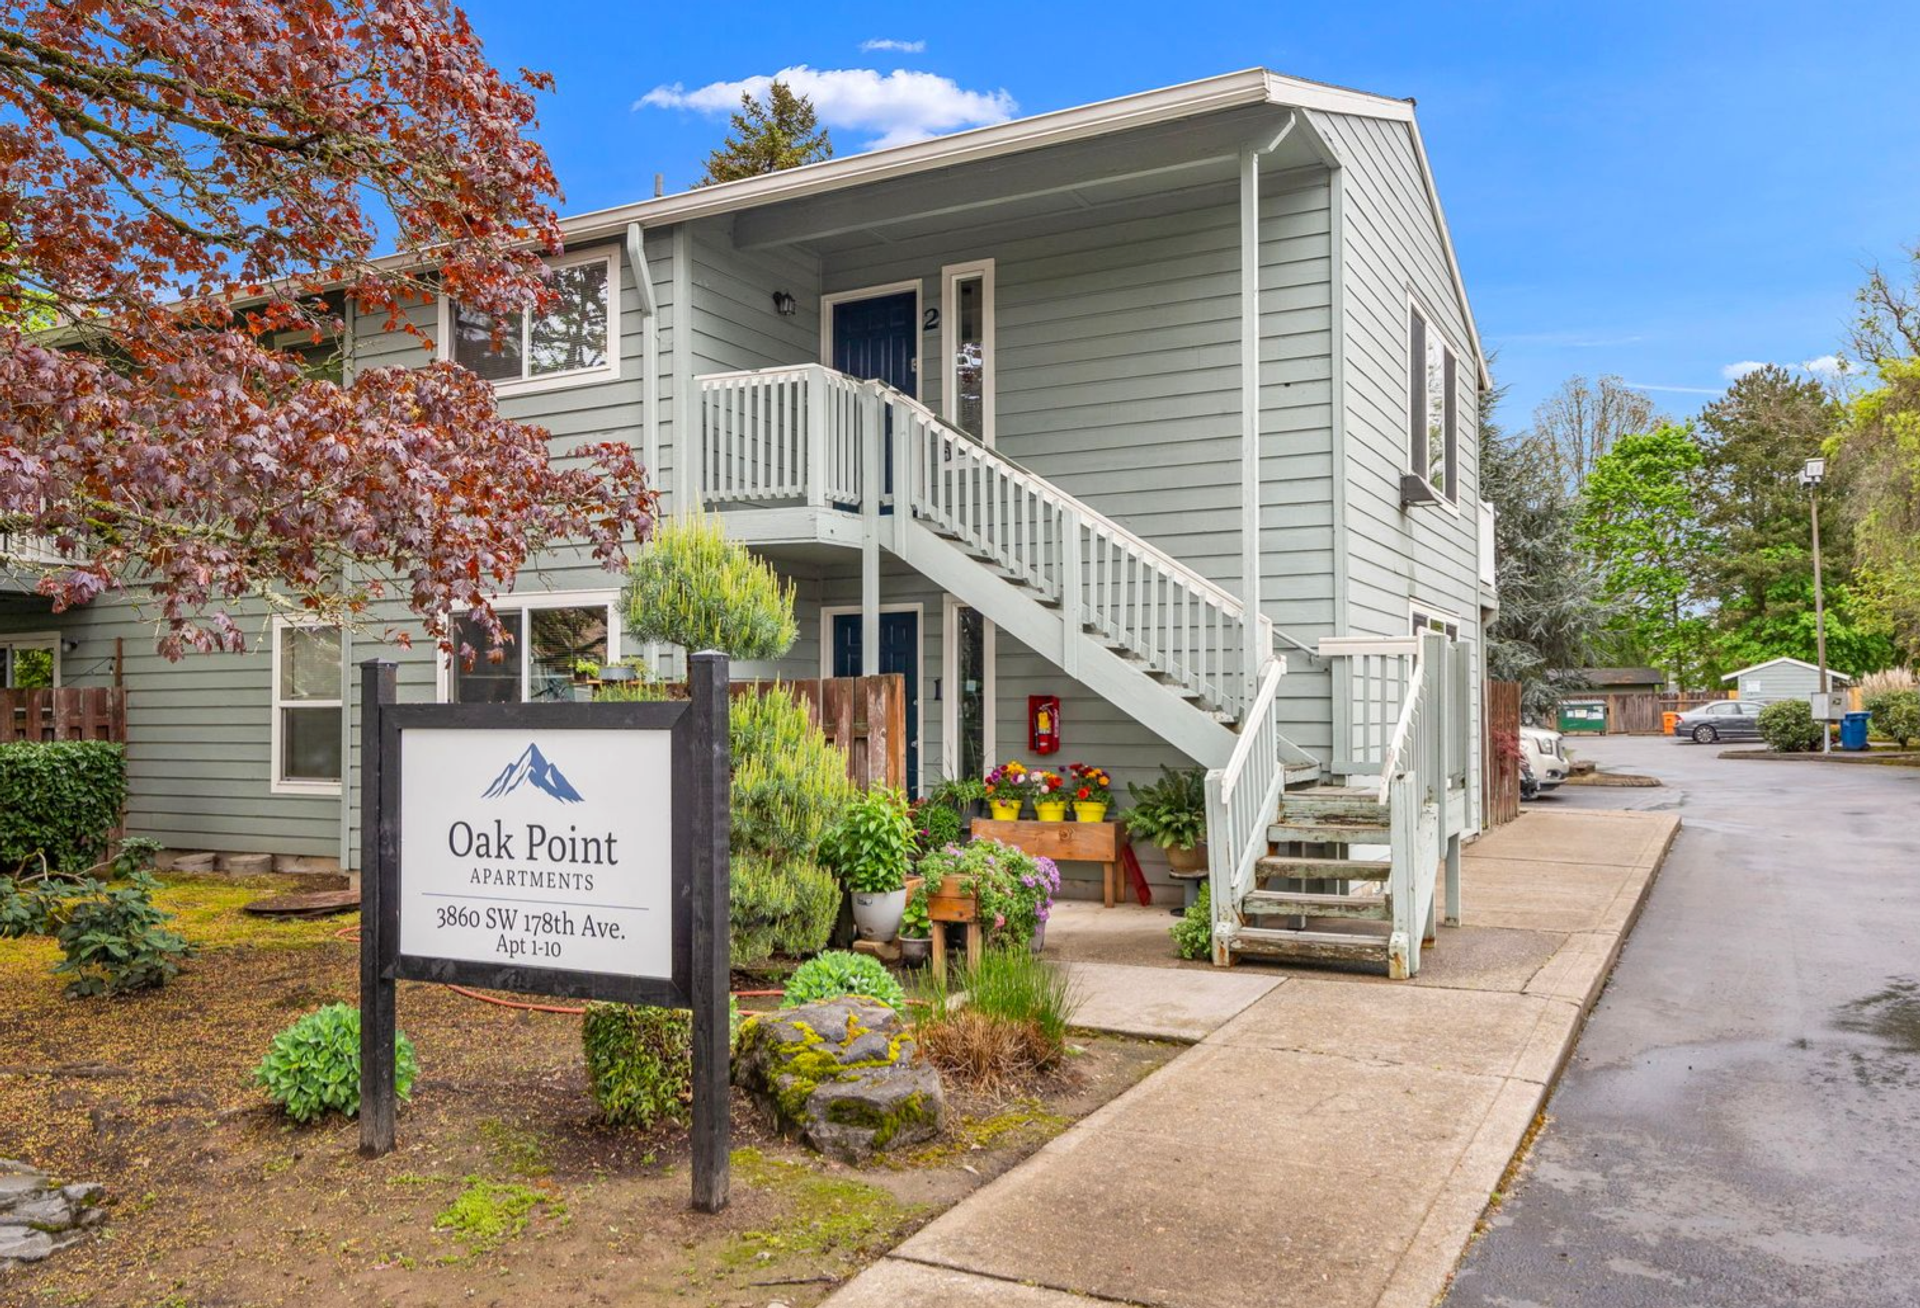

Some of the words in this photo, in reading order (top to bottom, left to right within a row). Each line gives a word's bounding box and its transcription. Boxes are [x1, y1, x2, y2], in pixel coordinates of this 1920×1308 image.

[922, 308, 939, 331] 2
[448, 819, 515, 860] Oak
[526, 824, 619, 866] Point
[470, 867, 595, 891] APARTMENTS
[436, 905, 480, 929] 3860
[485, 907, 518, 931] SW
[523, 911, 574, 937] 178th
[581, 914, 626, 940] Ave.
[496, 934, 526, 958] Apt
[532, 939, 561, 957] 1-10
